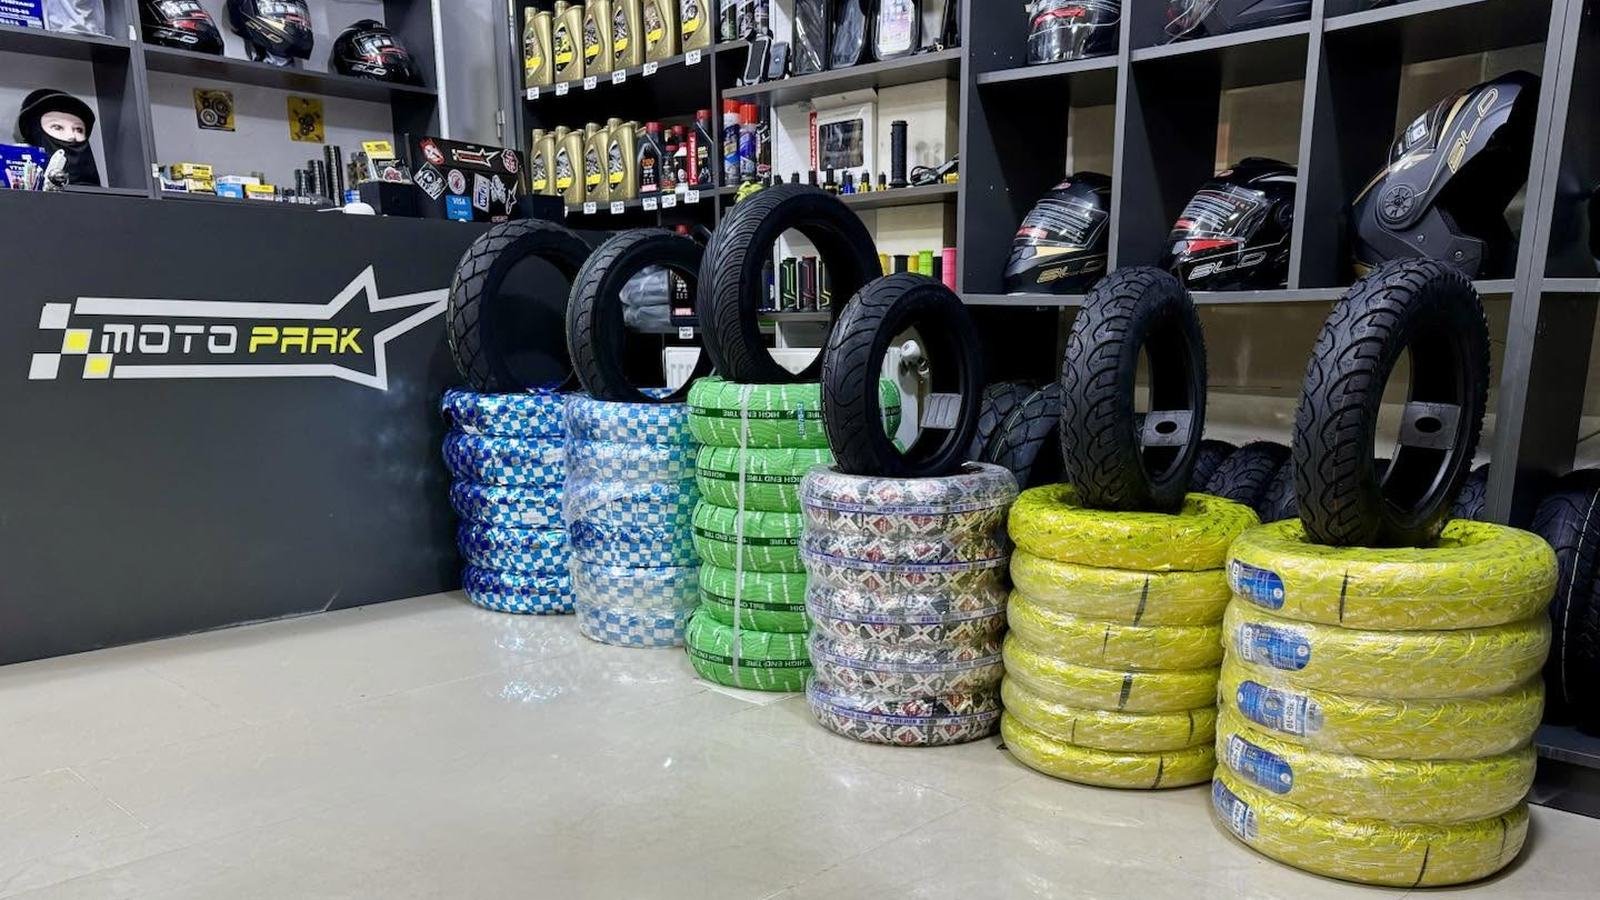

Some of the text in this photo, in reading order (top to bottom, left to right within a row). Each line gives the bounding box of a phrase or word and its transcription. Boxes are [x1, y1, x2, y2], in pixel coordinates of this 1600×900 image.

[1447, 88, 1499, 174] BLD
[1188, 251, 1268, 280] BLD
[1036, 258, 1107, 284] BLD
[100, 323, 364, 354] MOTO PARK
[722, 409, 739, 418] TIRE
[758, 409, 780, 418] HIGH
[763, 475, 782, 483] END
[769, 538, 787, 546] TIRE
[745, 659, 762, 667] TIRE
[764, 660, 783, 668] END
